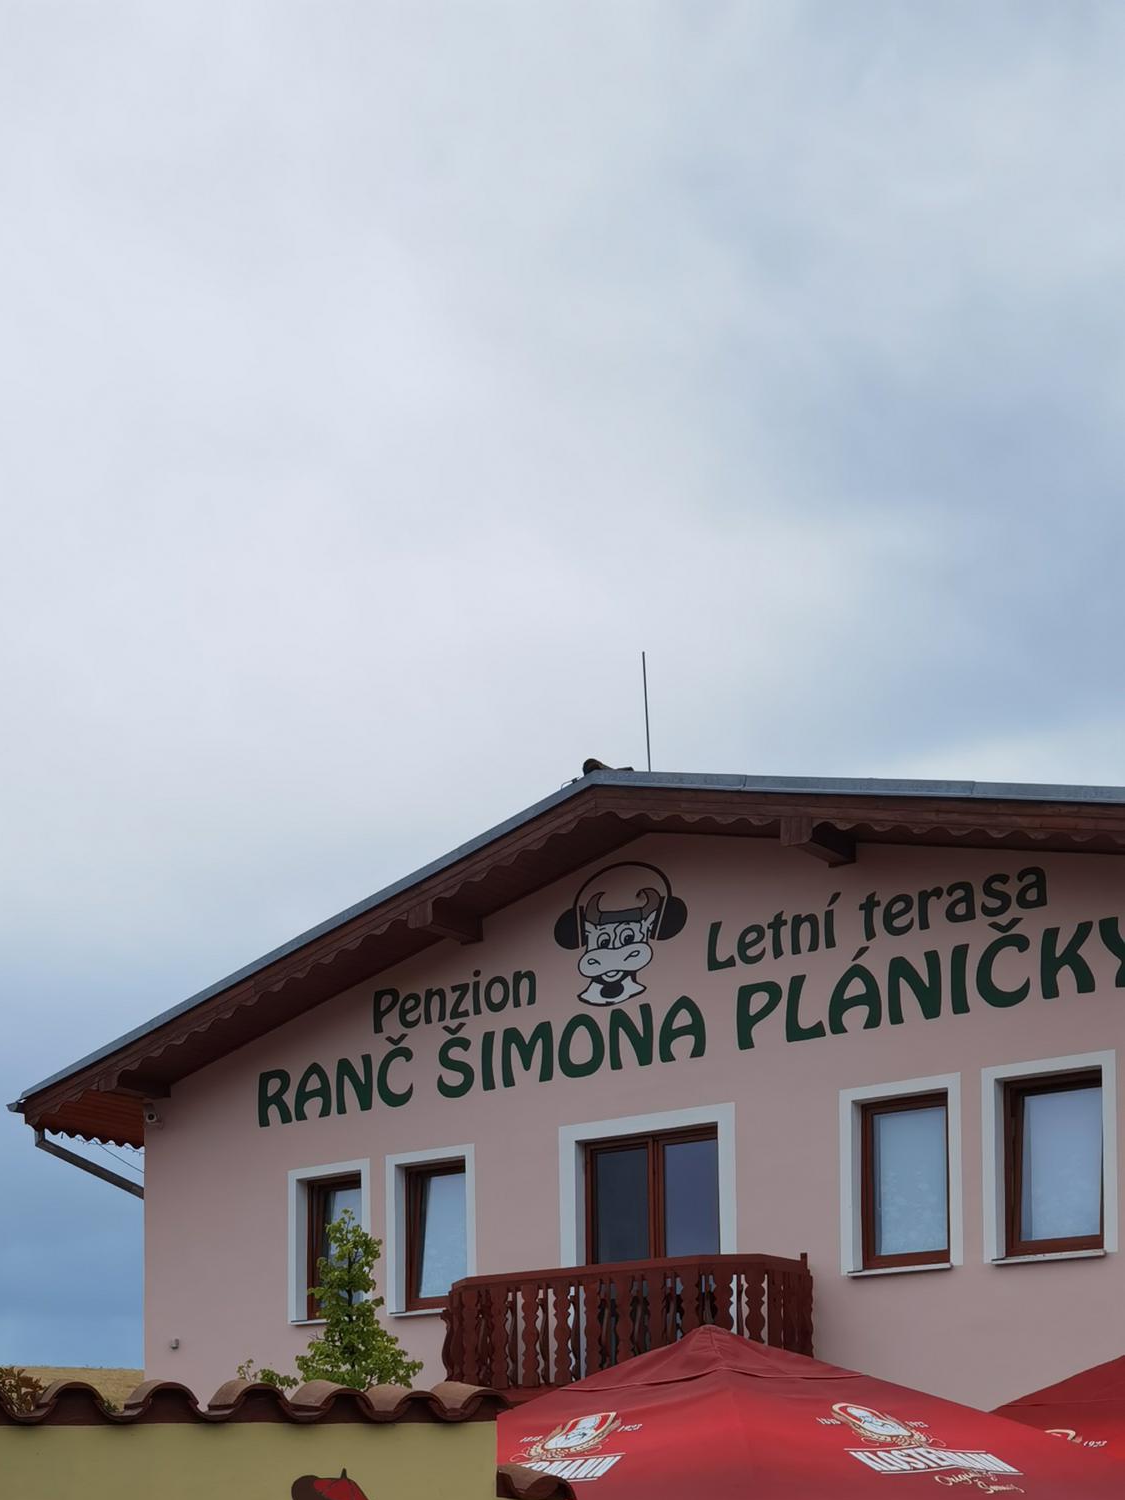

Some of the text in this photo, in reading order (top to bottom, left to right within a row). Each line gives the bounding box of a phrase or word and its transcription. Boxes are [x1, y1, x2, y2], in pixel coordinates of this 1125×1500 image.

[707, 866, 1048, 971] Letní terasa
[373, 969, 536, 1033] Penzion
[258, 1033, 413, 1127] RANČ
[437, 995, 706, 1098] ŠIMONA
[849, 1446, 1020, 1473] KLOSTERMANN
